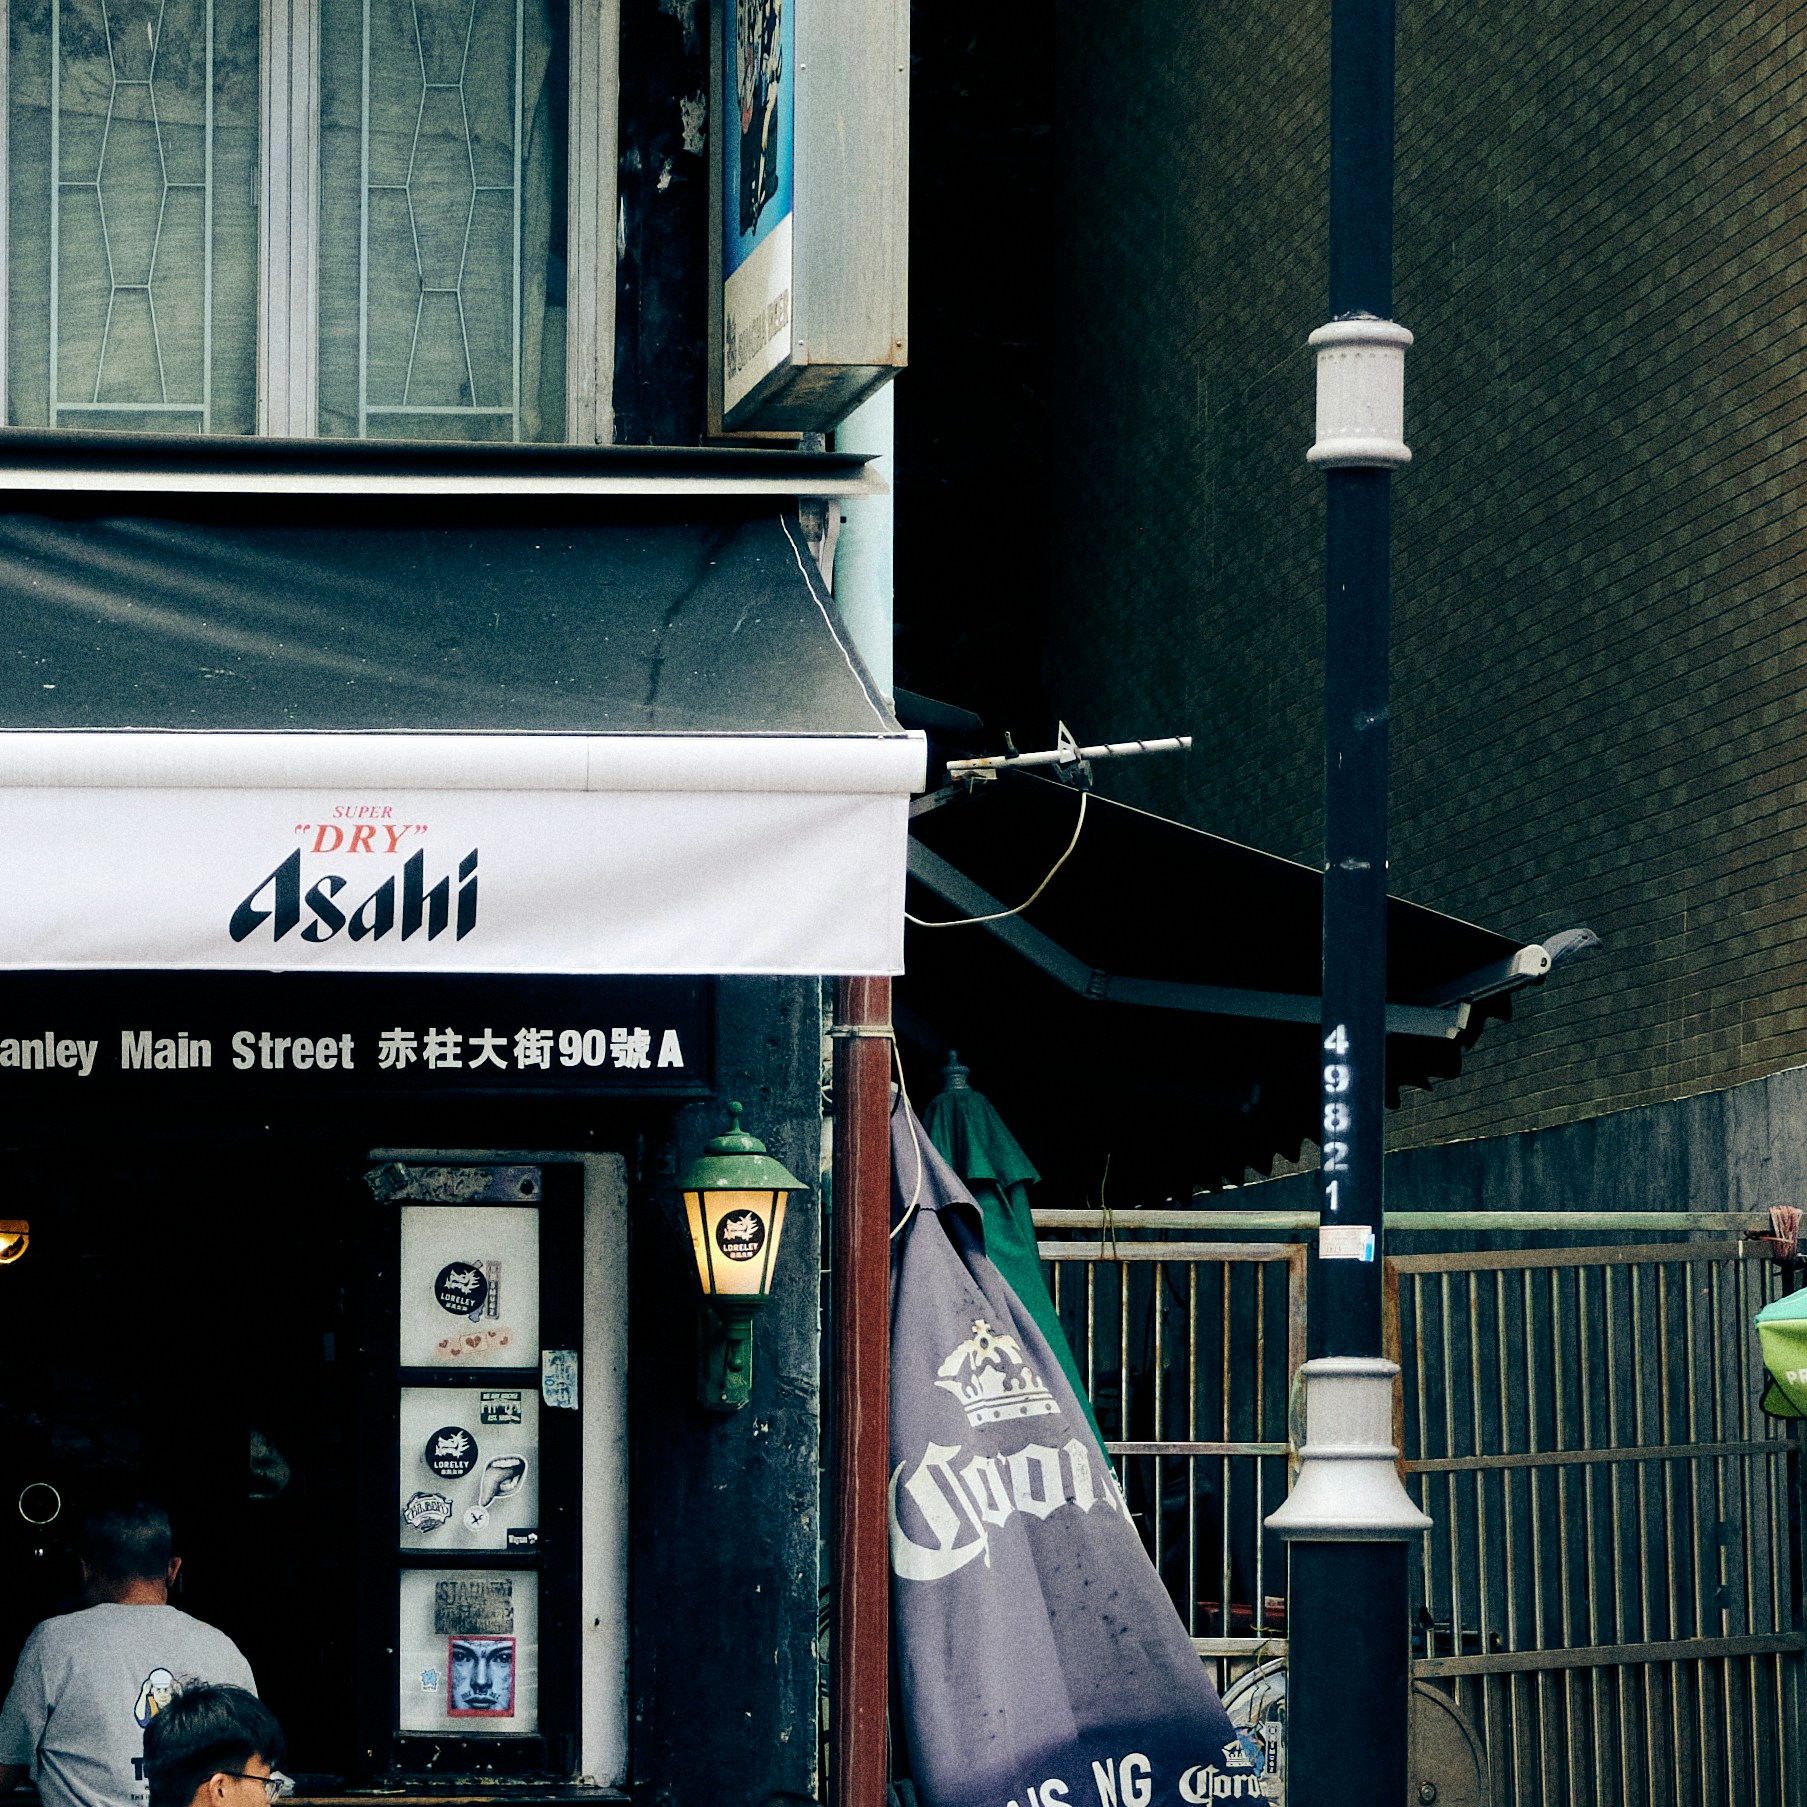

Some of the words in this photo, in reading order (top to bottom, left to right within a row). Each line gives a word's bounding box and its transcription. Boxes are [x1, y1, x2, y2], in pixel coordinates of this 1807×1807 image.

[332, 805, 393, 819] SUPER
[230, 847, 479, 944] Asahi
[122, 1031, 213, 1071] Main
[232, 1031, 356, 1071] Street
[378, 1027, 686, 1071] 赤柱大街90號A
[1323, 1023, 1352, 1211] 49821
[440, 1292, 477, 1308] LORELEY
[433, 1460, 470, 1469] LORELEY
